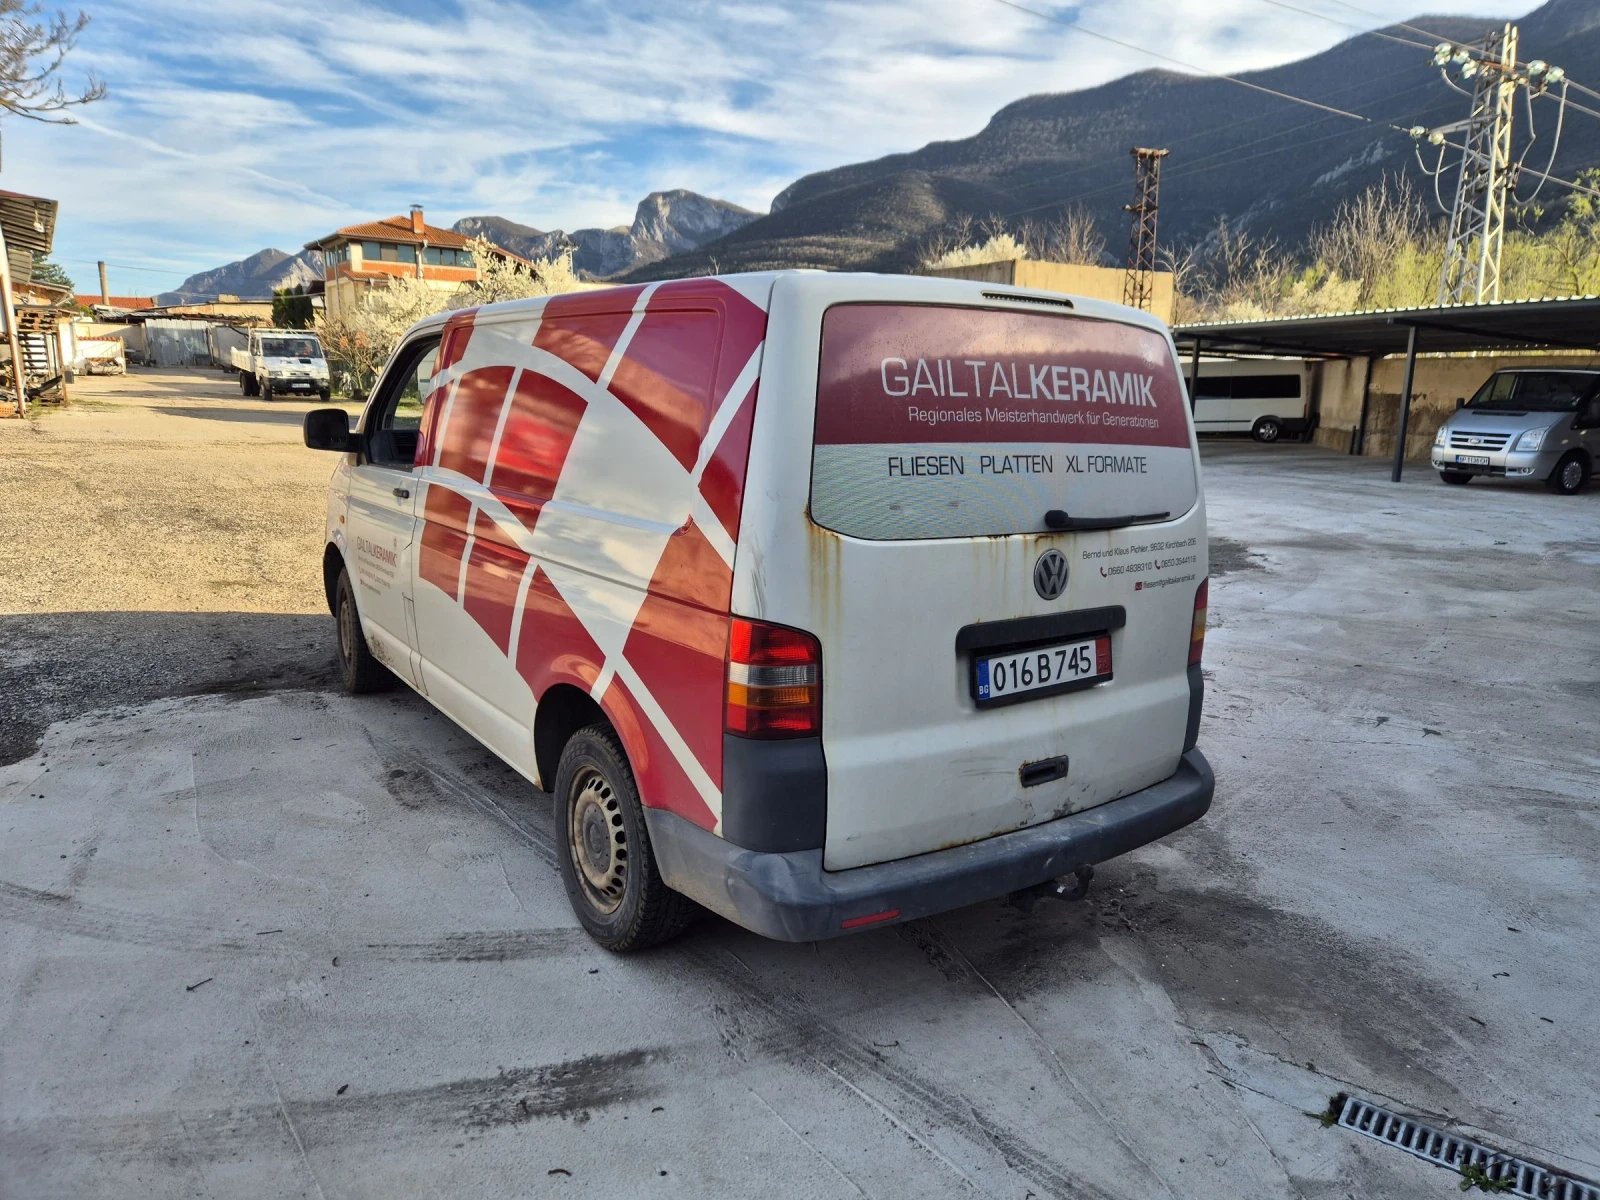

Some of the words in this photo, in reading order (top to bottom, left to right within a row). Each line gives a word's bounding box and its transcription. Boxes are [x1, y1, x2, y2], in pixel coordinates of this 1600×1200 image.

[881, 357, 1157, 408] GAILTALKERAMIK
[908, 406, 982, 426] Regionales
[985, 407, 1085, 425] Meisterhandwerk
[1086, 410, 1101, 425] für
[1102, 411, 1160, 429] Generationen
[888, 455, 965, 476] FLIESEN
[980, 455, 1053, 474] PLATTEN
[1065, 455, 1084, 473] XL
[1087, 455, 1148, 474] FORMATE
[1083, 549, 1102, 560] Bernd
[1102, 548, 1114, 558] und
[1114, 547, 1130, 556] Klaus
[1150, 542, 1165, 552] 9632
[979, 684, 989, 695] BG
